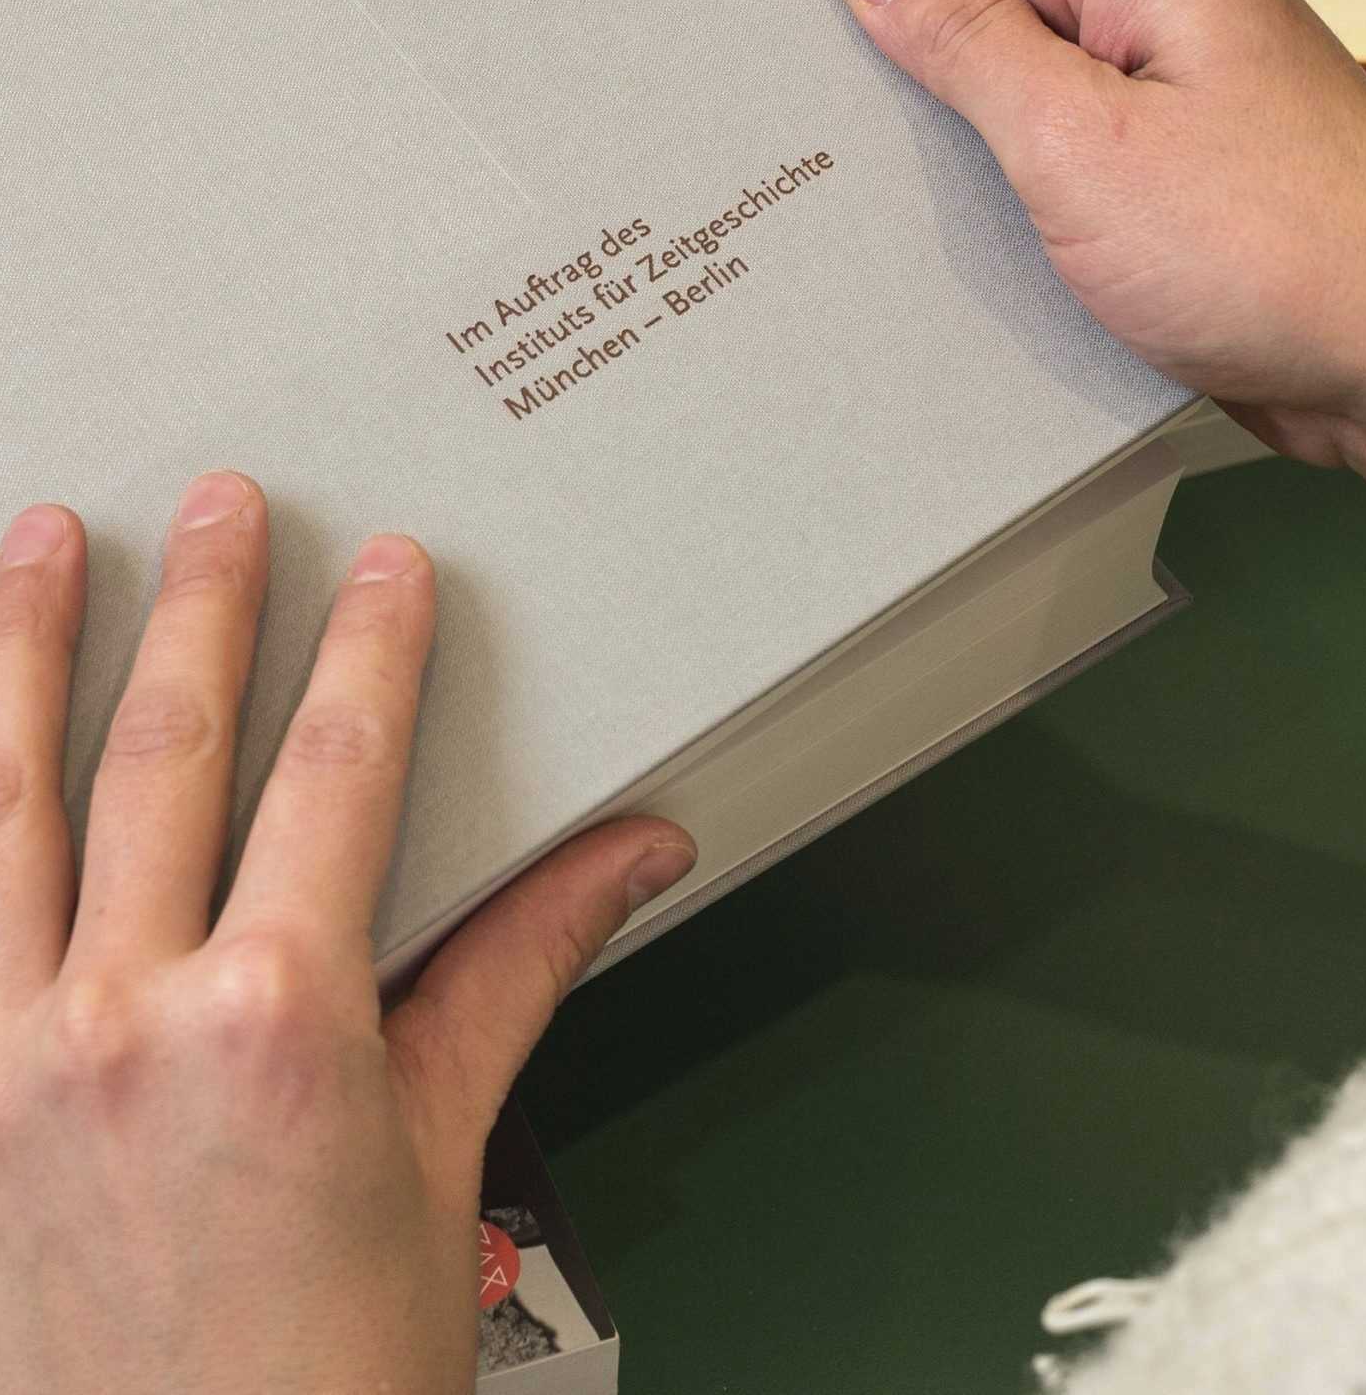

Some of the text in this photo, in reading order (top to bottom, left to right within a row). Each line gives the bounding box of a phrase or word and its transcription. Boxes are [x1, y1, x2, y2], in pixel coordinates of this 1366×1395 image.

[446, 217, 652, 355] Im Auftrag des
[474, 151, 835, 388] Instituts für Zeitgeschichte
[502, 325, 641, 421] München
[662, 254, 750, 317] Berlin
